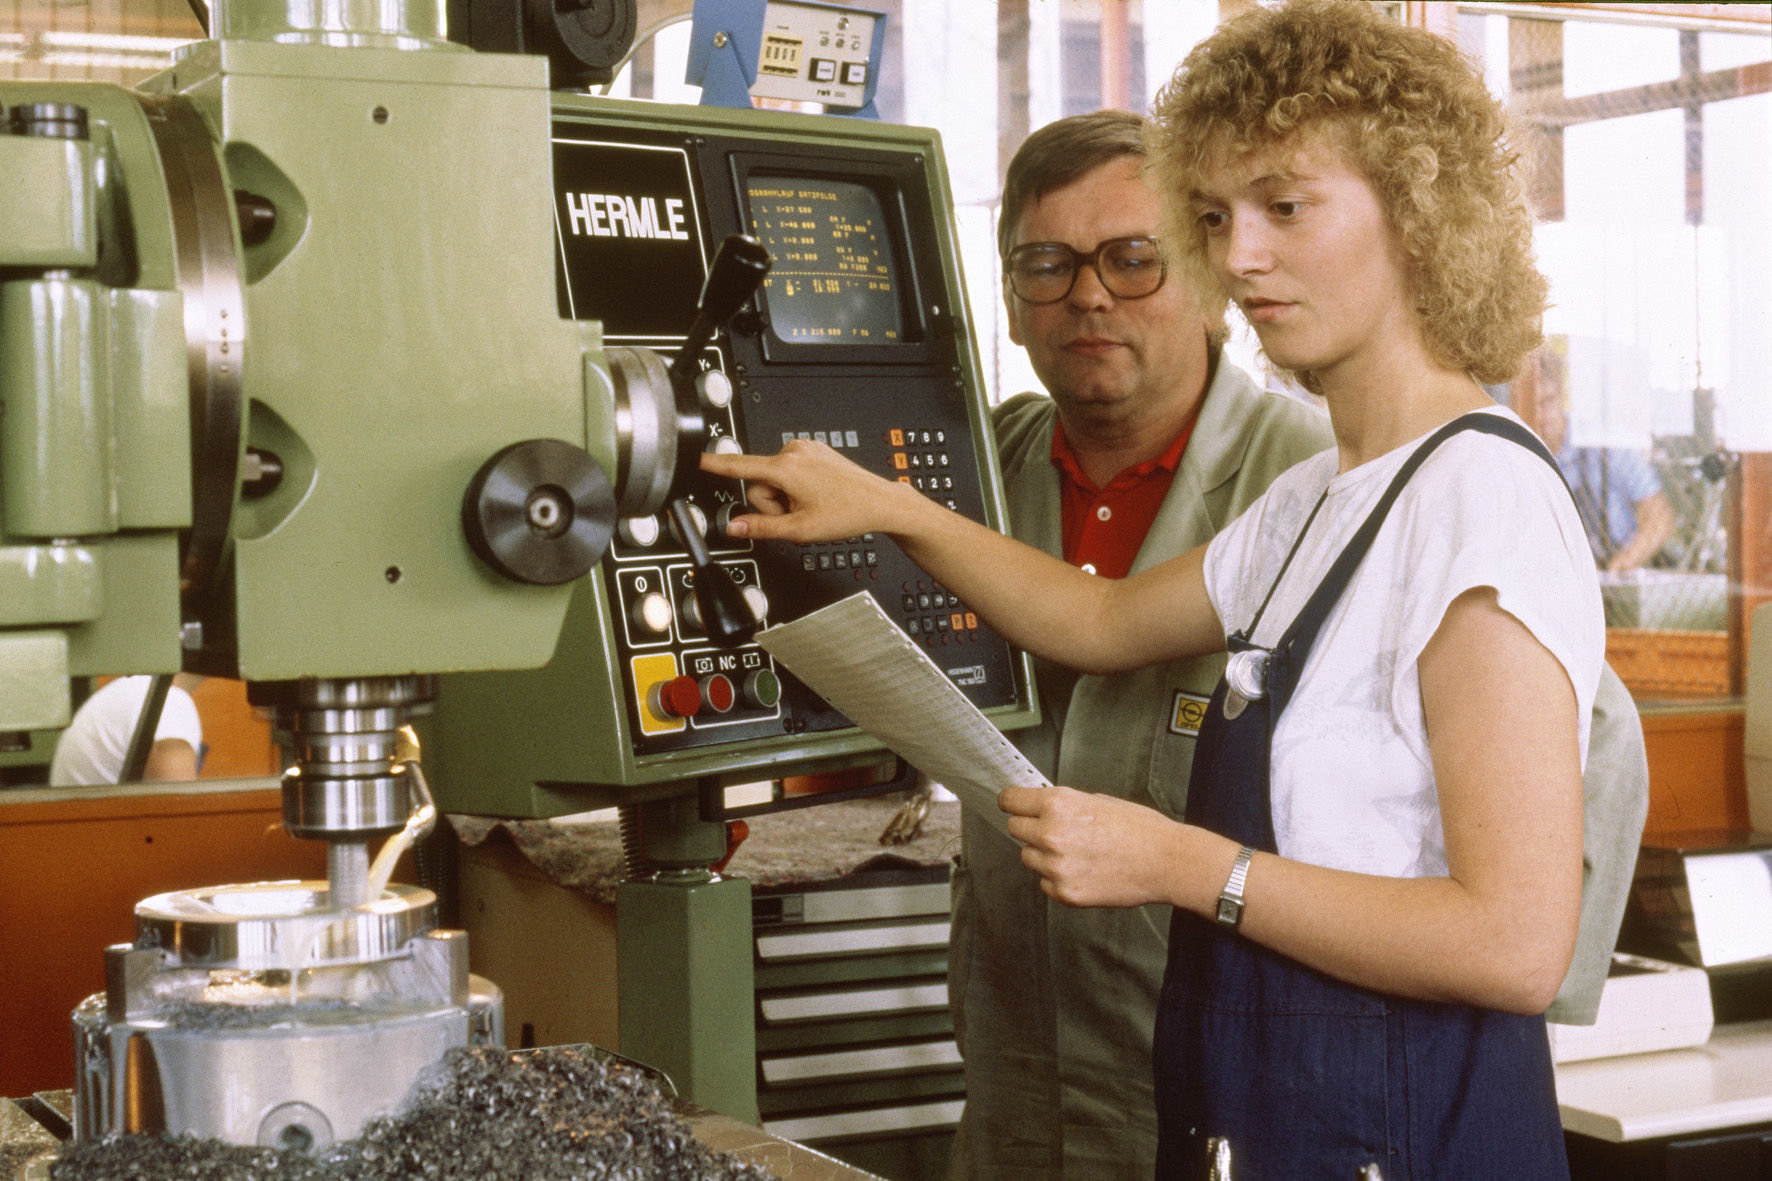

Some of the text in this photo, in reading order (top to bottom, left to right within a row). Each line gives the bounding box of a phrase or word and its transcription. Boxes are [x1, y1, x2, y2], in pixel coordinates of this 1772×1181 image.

[566, 192, 689, 240] HERMLE
[699, 359, 711, 371] Y+
[908, 432, 915, 442] 7
[923, 432, 930, 442] 8
[938, 432, 944, 442] 9
[913, 456, 919, 465] 4
[927, 455, 934, 465] 5
[941, 455, 948, 465] 6
[918, 478, 922, 488] 1
[931, 478, 938, 488] 2
[945, 477, 951, 488] 3
[719, 655, 736, 670] NC
